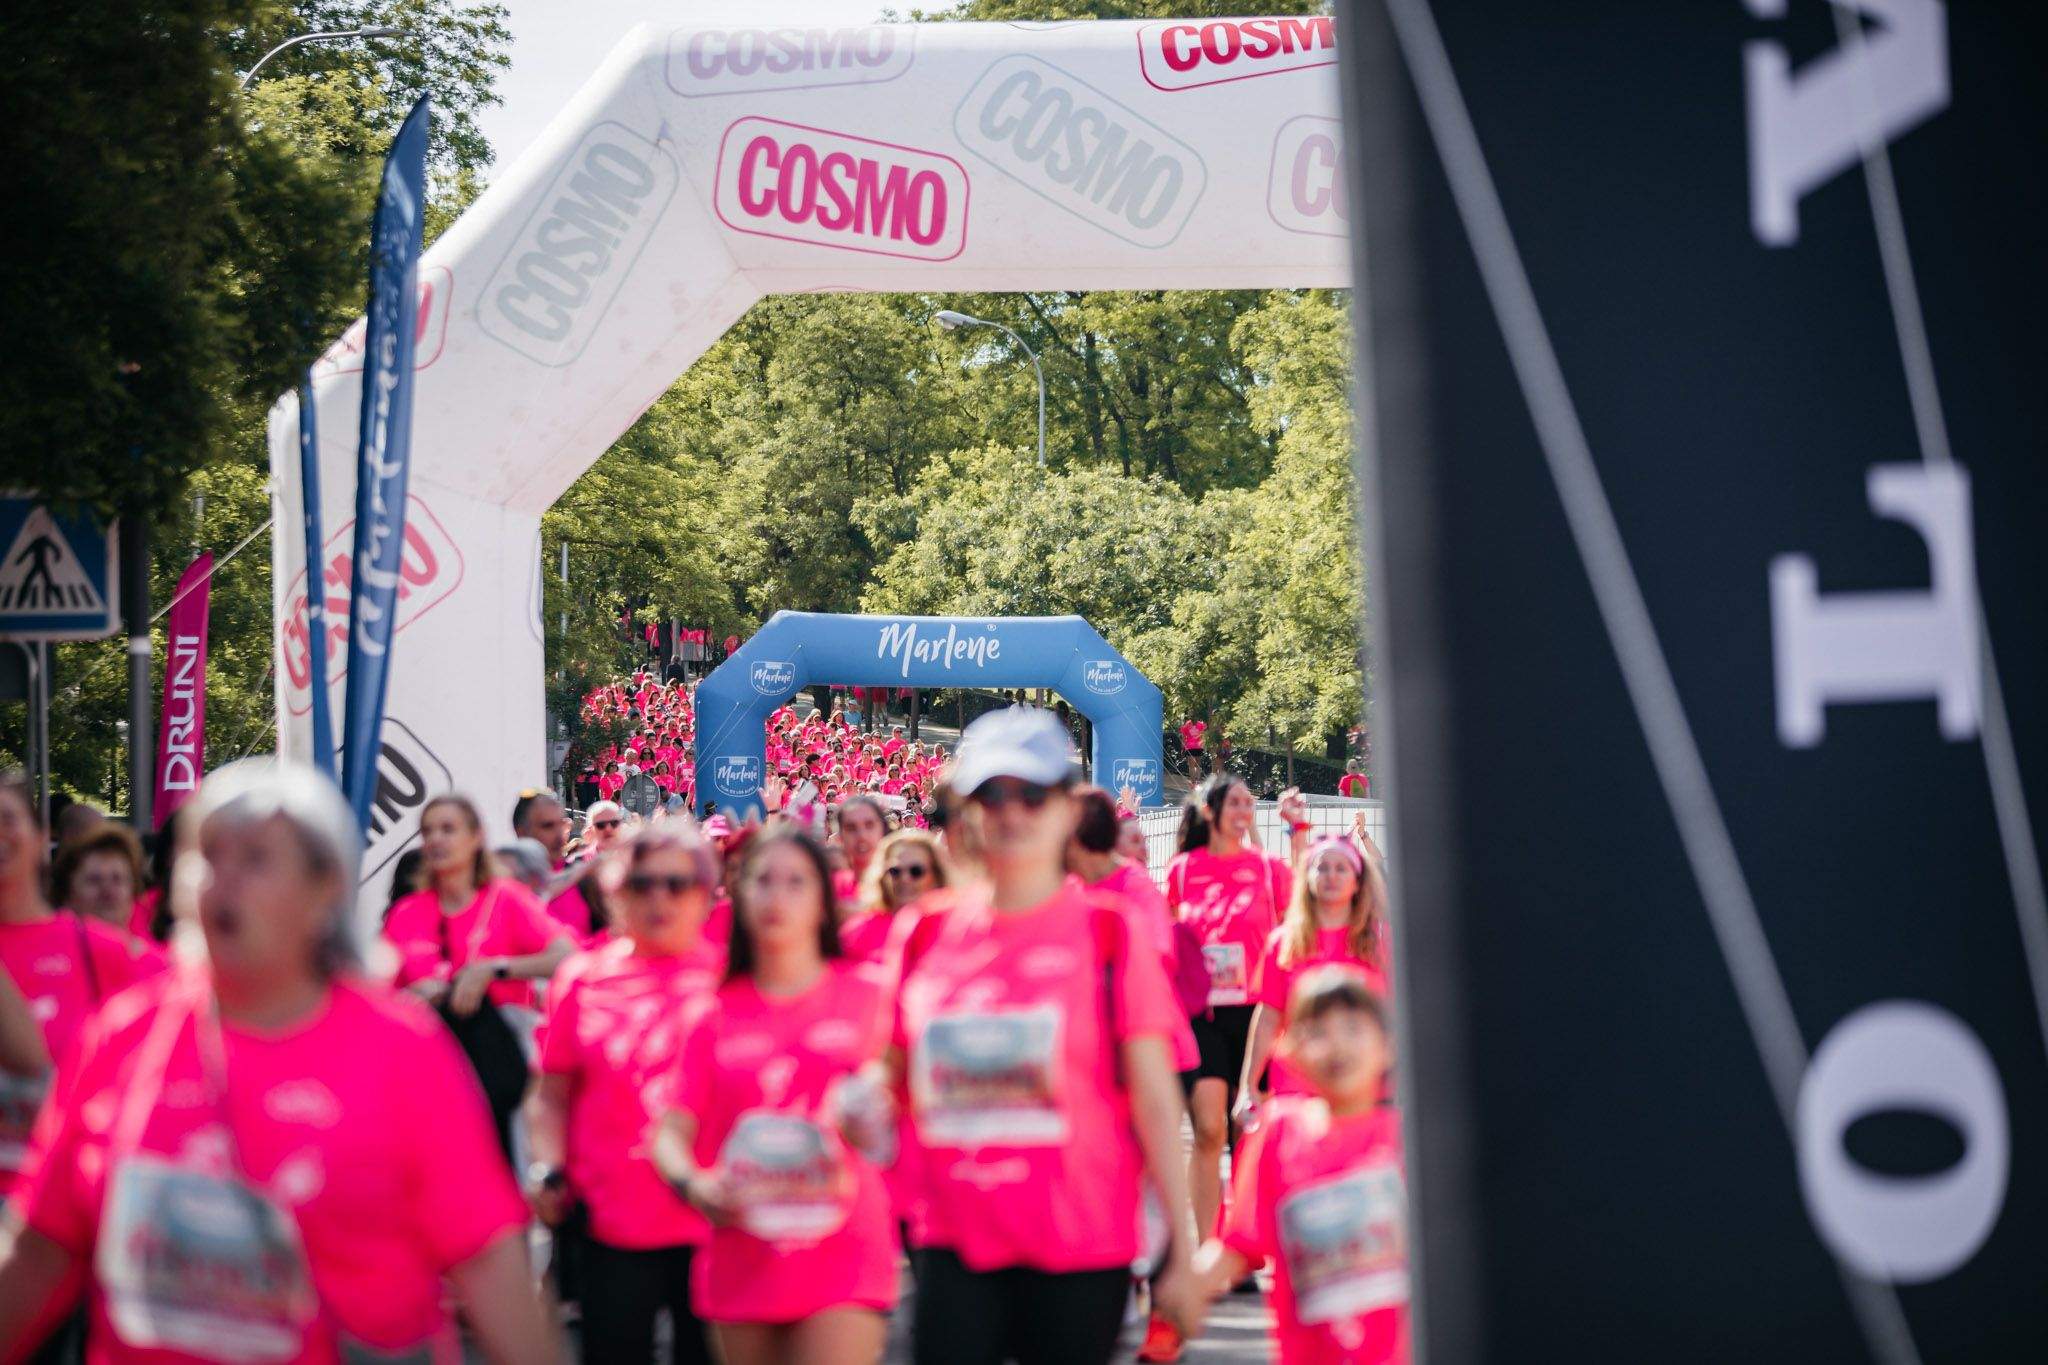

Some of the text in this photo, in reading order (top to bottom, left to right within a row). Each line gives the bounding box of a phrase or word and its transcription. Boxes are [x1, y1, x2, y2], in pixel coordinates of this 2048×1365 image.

[686, 28, 896, 81] COSMO
[1160, 17, 1336, 72] COSM
[979, 69, 1184, 231] COSMO
[738, 135, 949, 246] COSMO
[497, 141, 657, 343] COSMO
[754, 668, 791, 686] Marlene
[1087, 668, 1124, 686] Marlene
[162, 635, 200, 791] DRUNI
[717, 765, 758, 786] Marlene
[1116, 767, 1156, 788] Marlene
